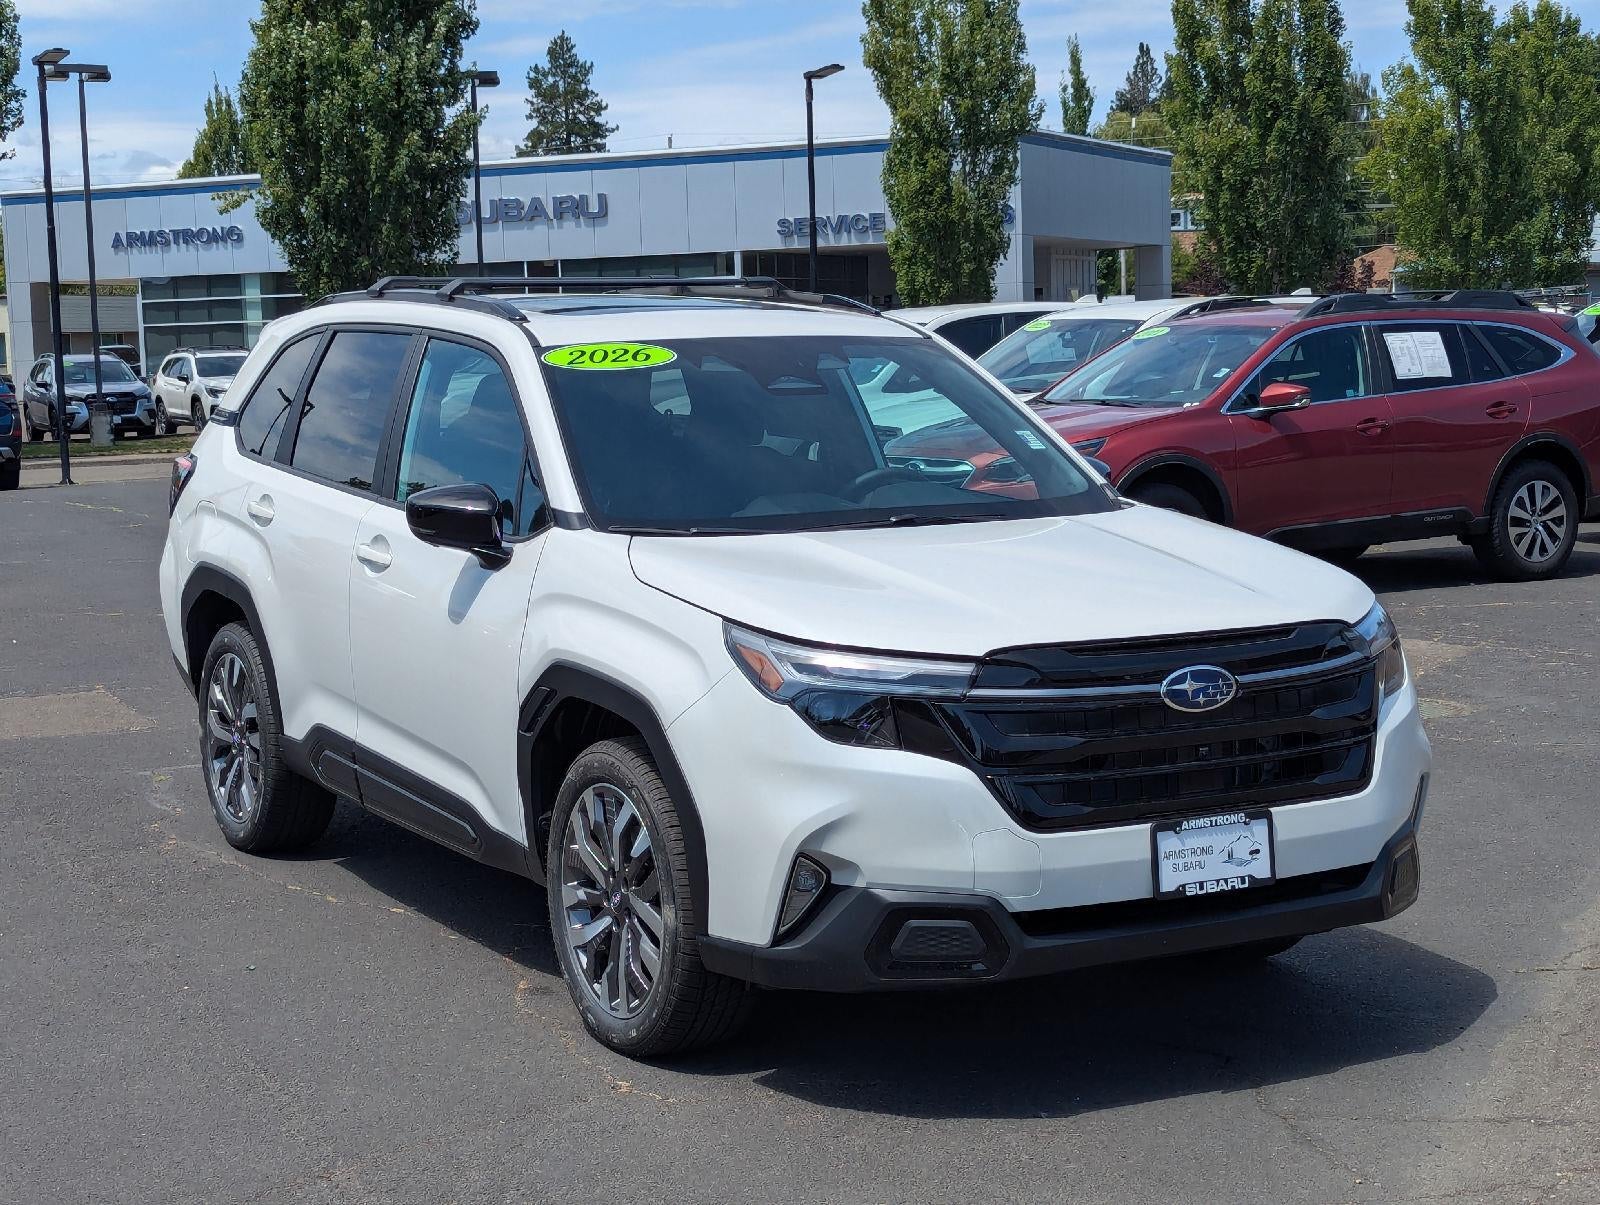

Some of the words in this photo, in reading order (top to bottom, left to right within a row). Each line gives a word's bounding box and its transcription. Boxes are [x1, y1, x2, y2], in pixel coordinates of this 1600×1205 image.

[776, 212, 886, 237] SERVICE
[111, 225, 244, 249] ARMSTRONG
[567, 347, 653, 366] 2026
[1181, 812, 1246, 831] ARMSTRONG
[1162, 845, 1214, 861] ARMSTRONG
[1171, 860, 1206, 873] SUBARU
[1185, 876, 1249, 896] SUBARU
